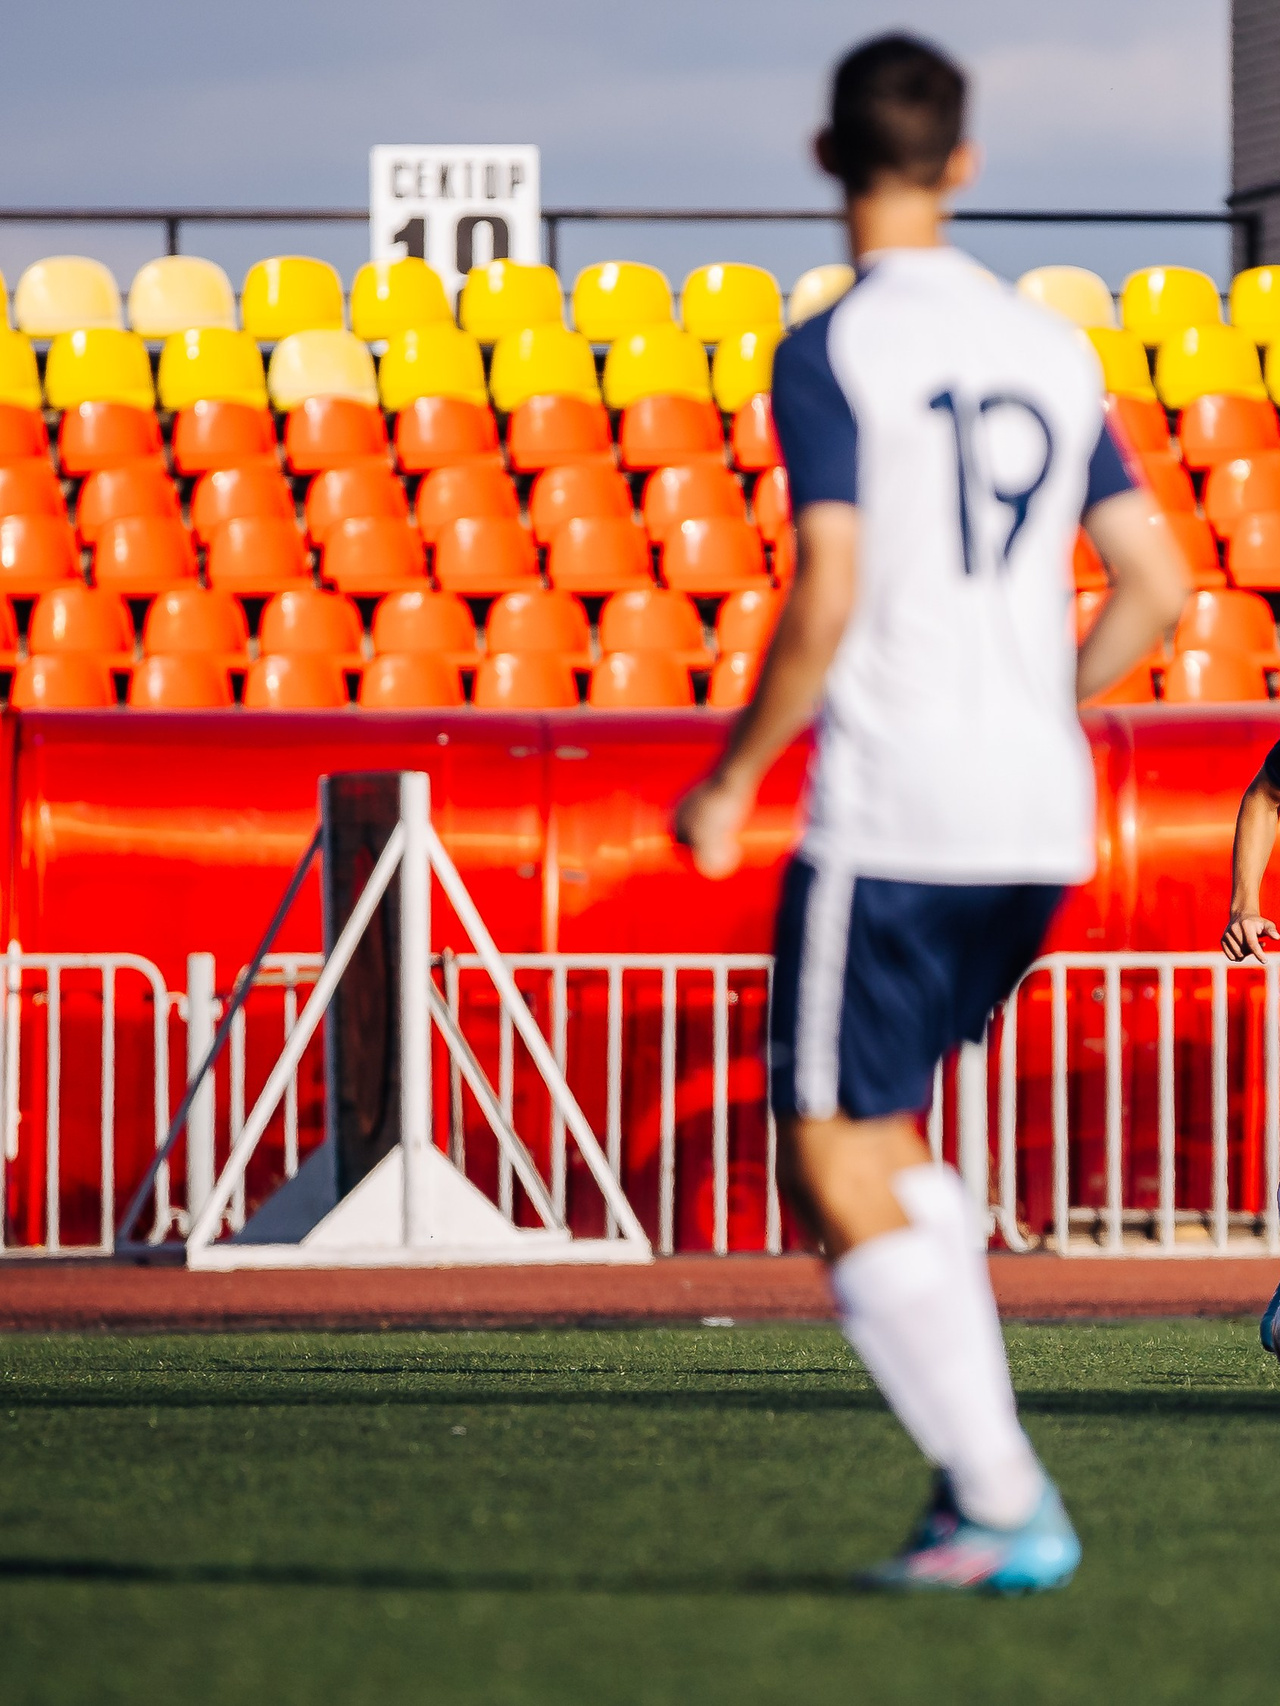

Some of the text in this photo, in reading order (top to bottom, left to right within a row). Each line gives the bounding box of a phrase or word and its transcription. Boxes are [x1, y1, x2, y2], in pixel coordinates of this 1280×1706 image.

[392, 160, 525, 199] СЕКТОР
[392, 215, 509, 275] 10
[928, 386, 1054, 576] 19
